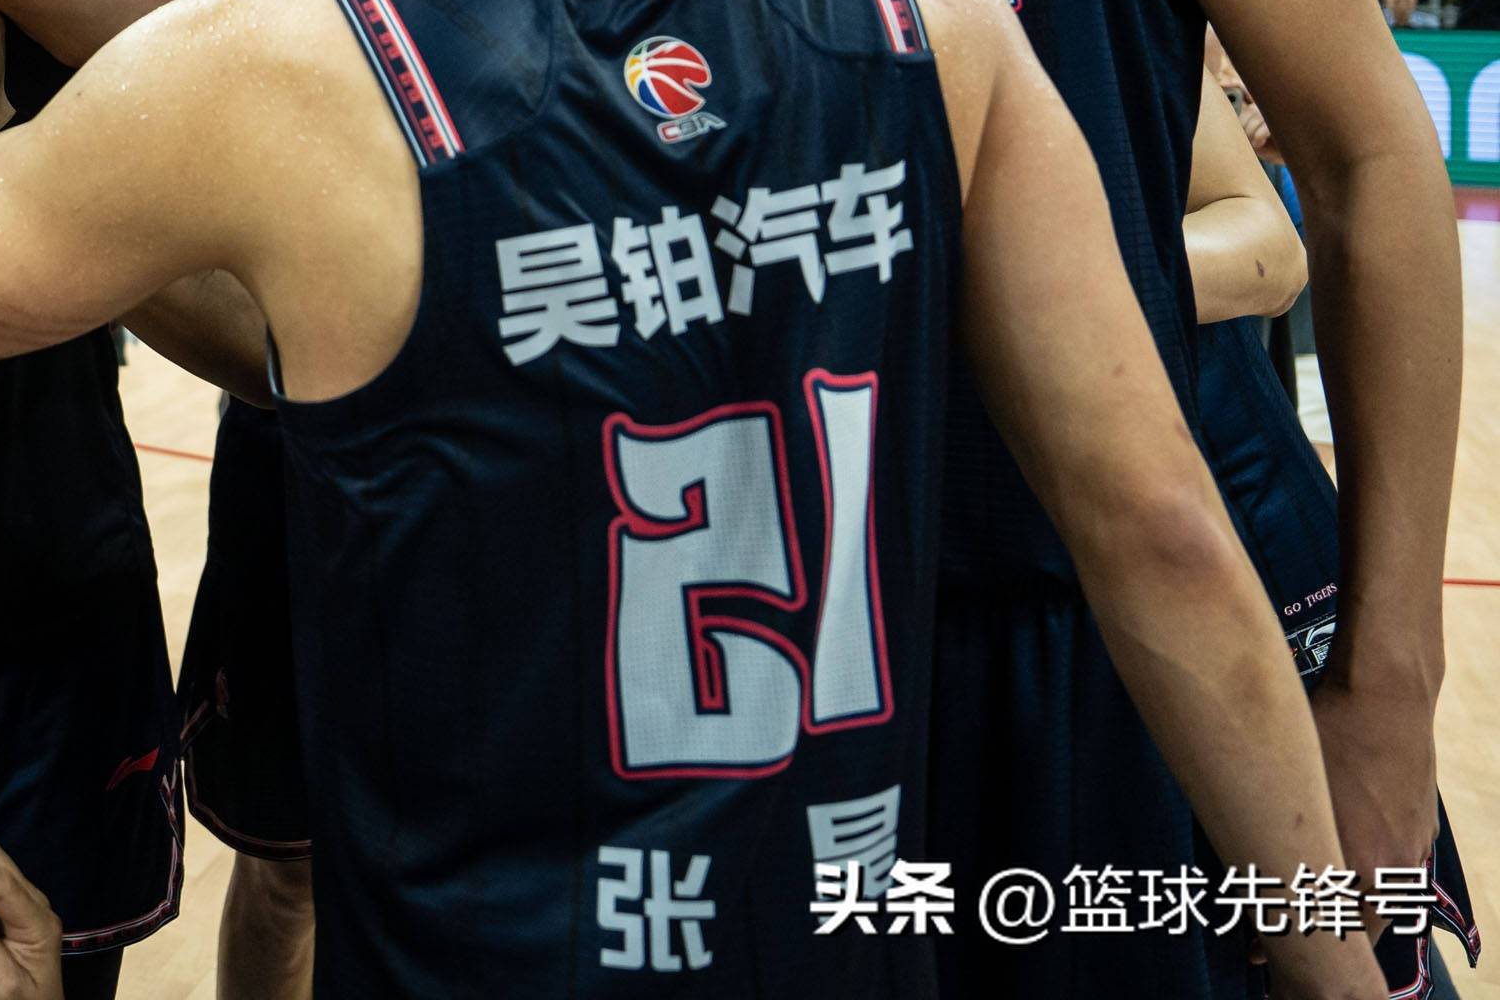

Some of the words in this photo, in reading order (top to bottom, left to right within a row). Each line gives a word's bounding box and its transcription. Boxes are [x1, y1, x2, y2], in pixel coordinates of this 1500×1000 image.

[496, 160, 914, 367] 昊铂汽车
[602, 368, 894, 780] 21
[1284, 602, 1302, 616] GO
[1304, 582, 1339, 608] TIGERS
[597, 845, 716, 972] 张
